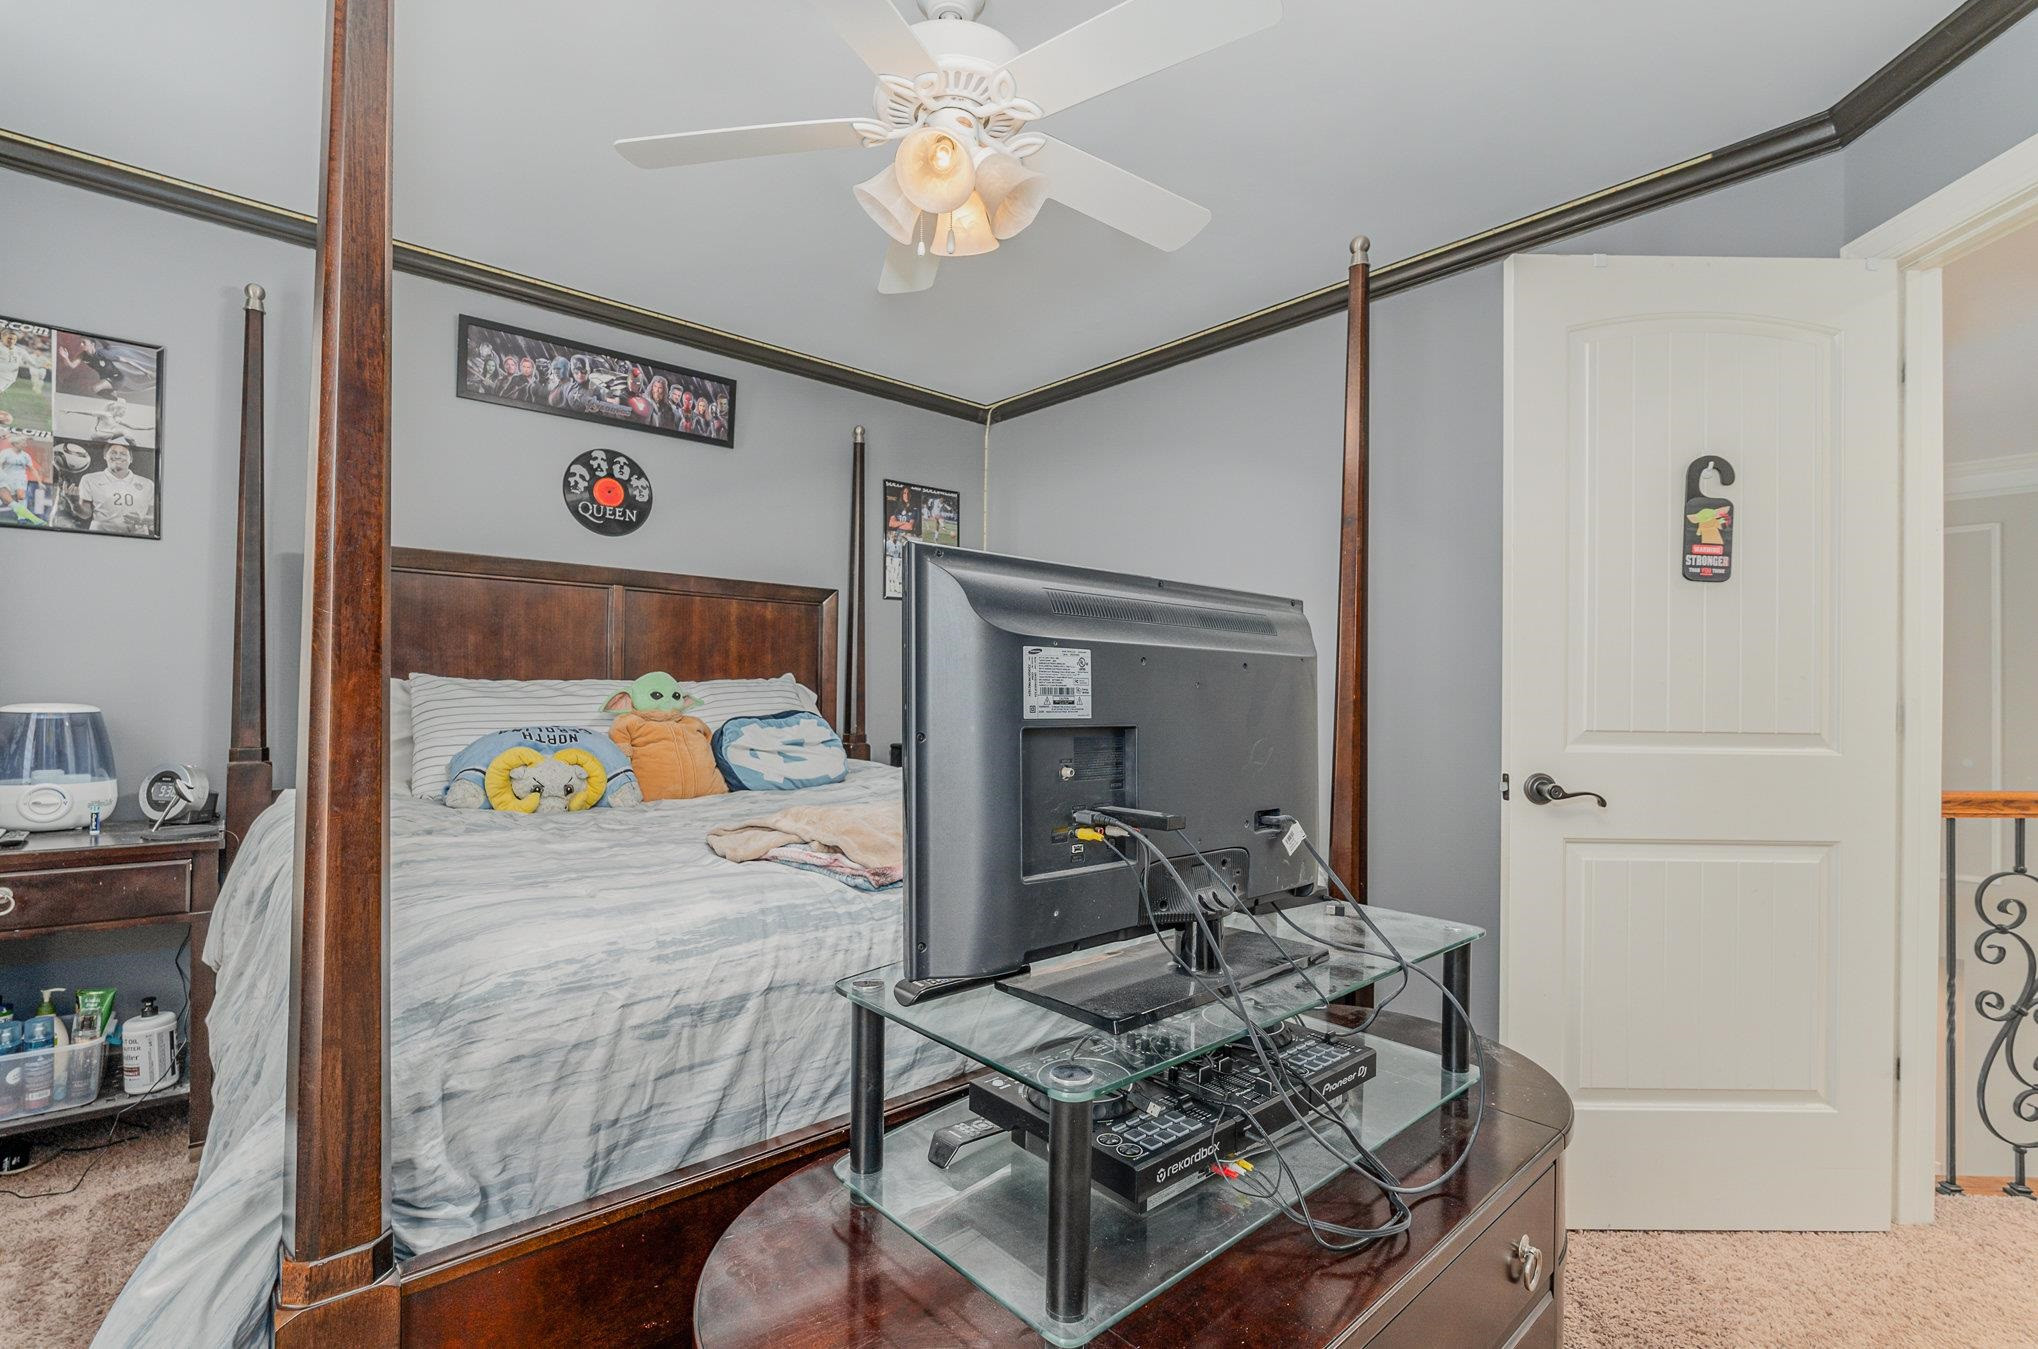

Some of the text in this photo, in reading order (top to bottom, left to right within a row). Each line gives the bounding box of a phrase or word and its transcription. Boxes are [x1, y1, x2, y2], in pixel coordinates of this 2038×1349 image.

[113, 493, 134, 507] 20
[578, 501, 637, 524] QUEEN
[1685, 555, 1729, 567] STRONGER
[521, 731, 579, 745] NORTH
[1322, 1072, 1357, 1096] Pioneer
[1167, 1141, 1221, 1177] rekordbox
